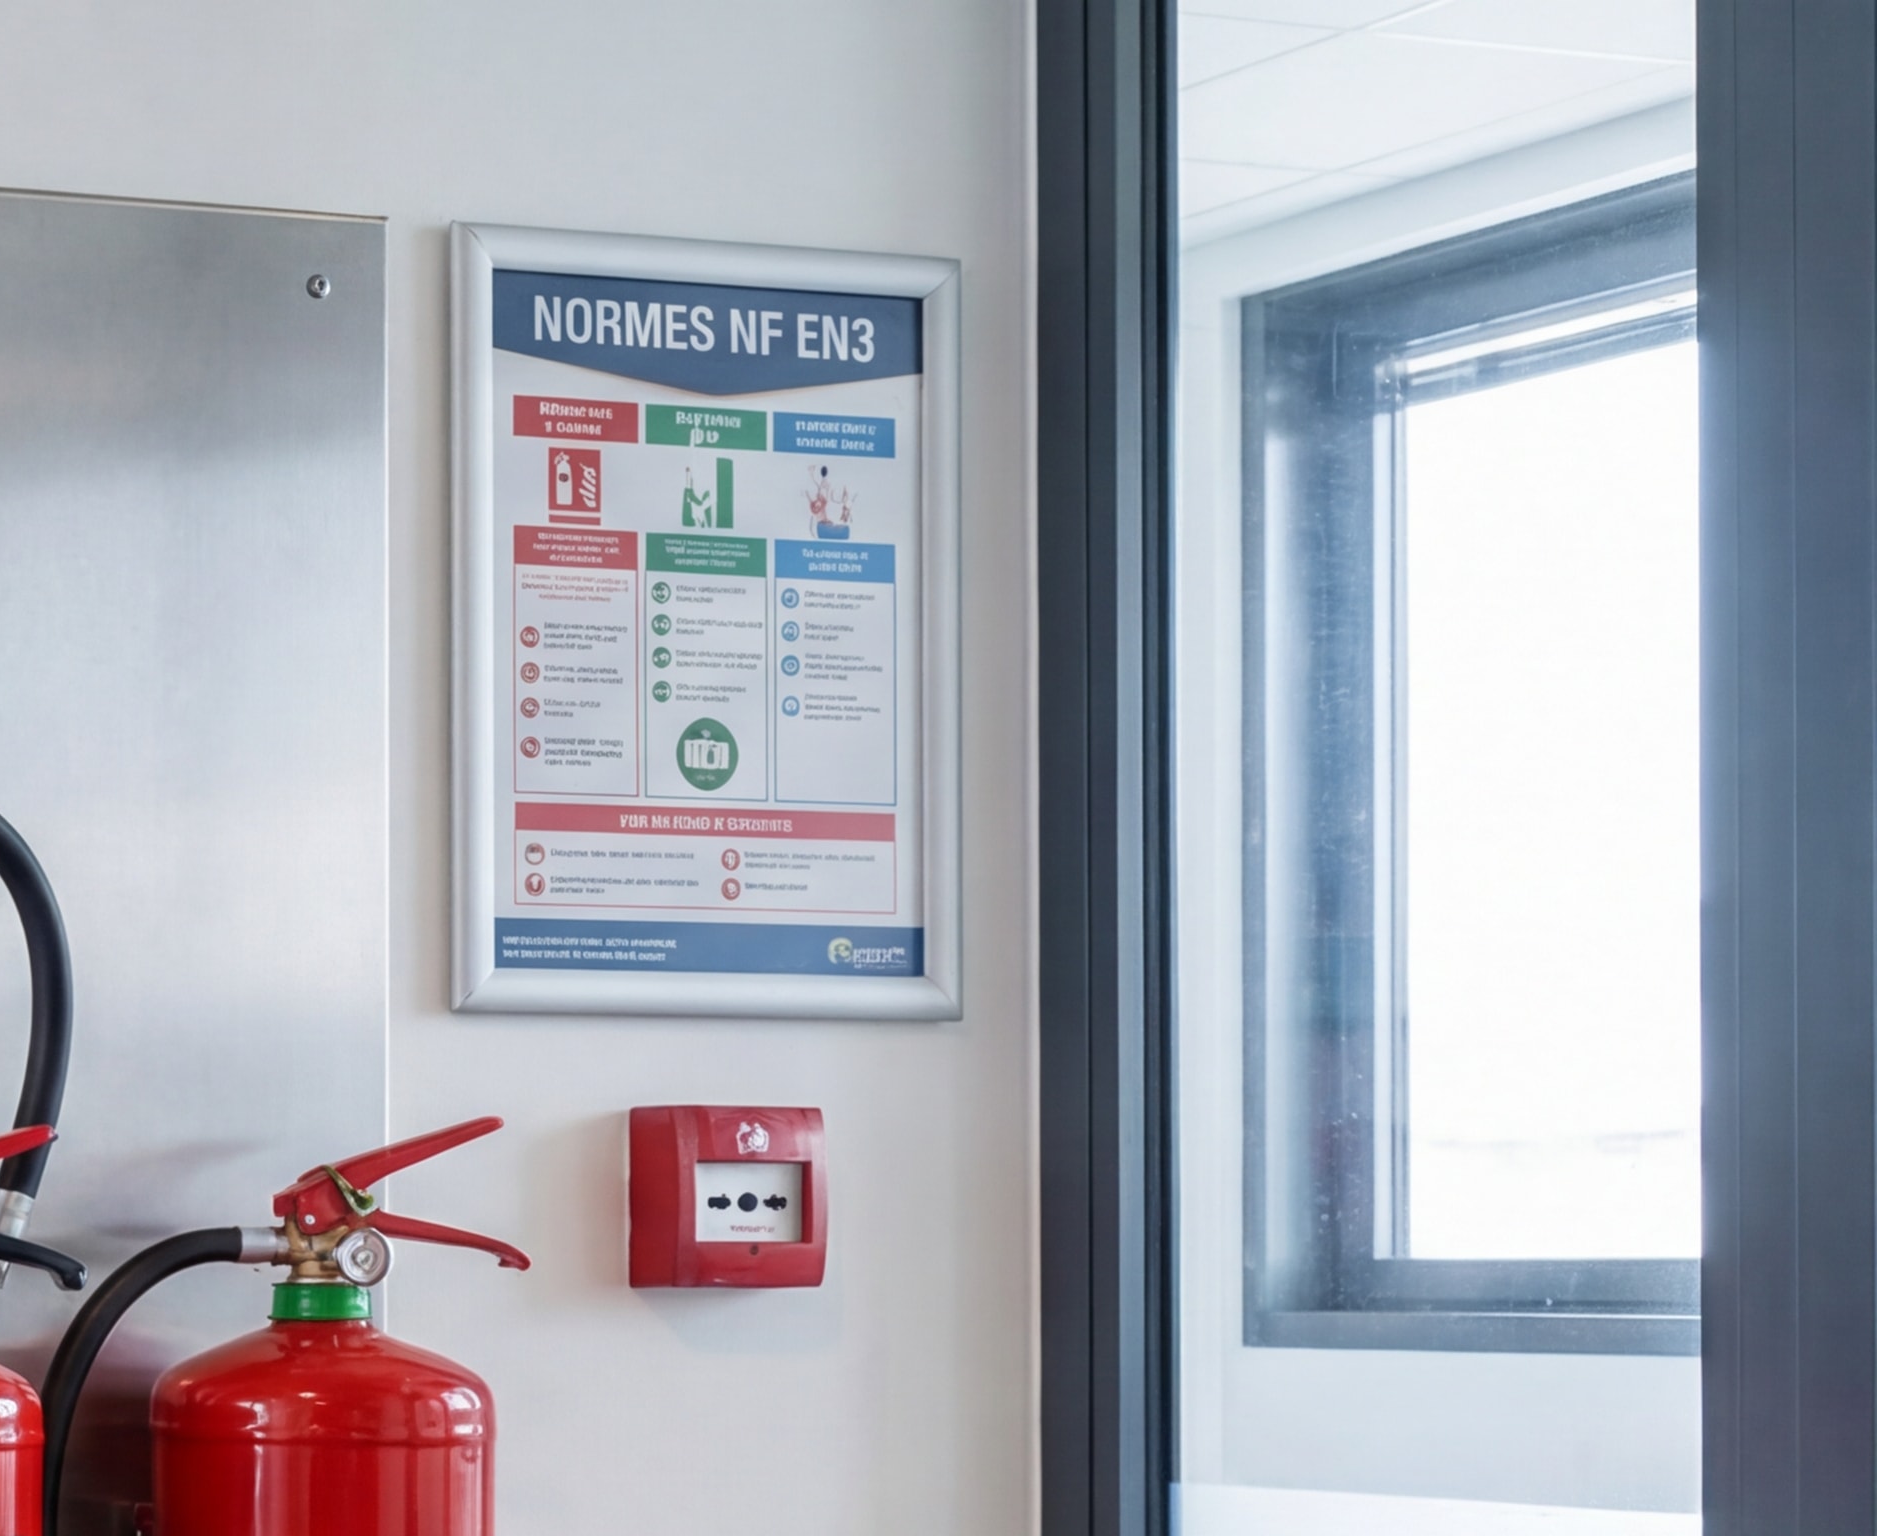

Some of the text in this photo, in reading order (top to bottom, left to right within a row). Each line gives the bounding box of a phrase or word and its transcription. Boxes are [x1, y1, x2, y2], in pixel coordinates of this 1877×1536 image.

[533, 295, 875, 363] NORMES NF EN3
